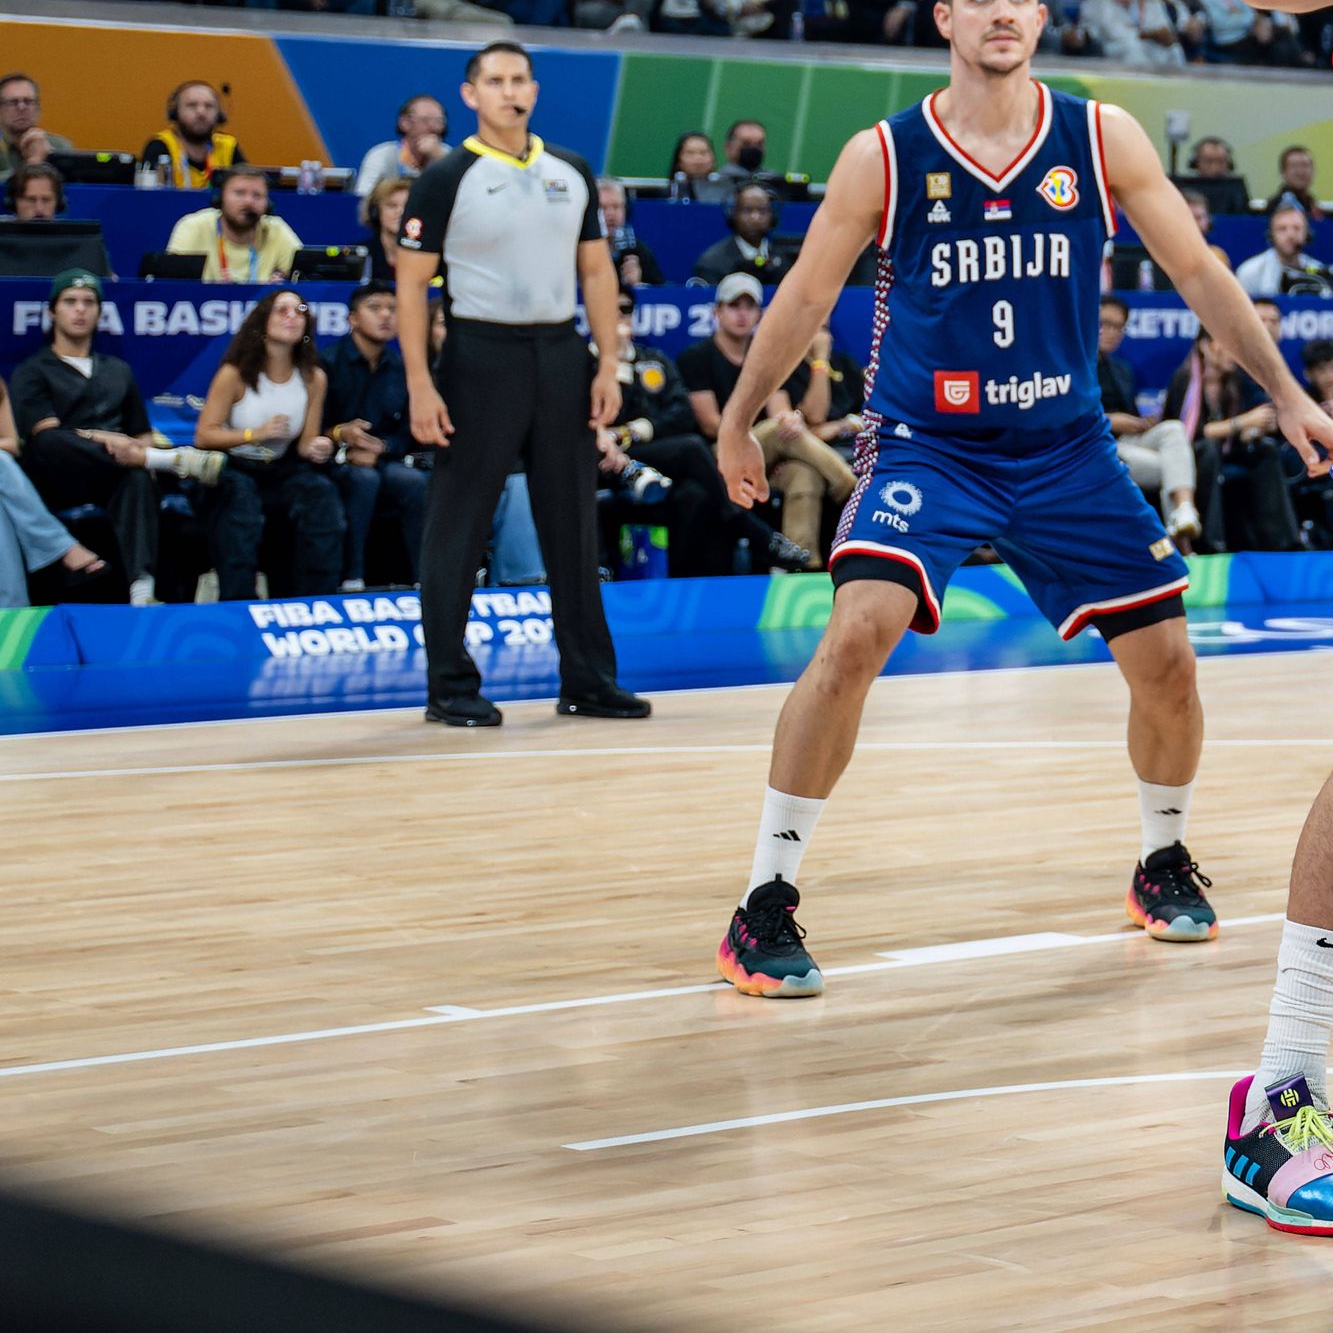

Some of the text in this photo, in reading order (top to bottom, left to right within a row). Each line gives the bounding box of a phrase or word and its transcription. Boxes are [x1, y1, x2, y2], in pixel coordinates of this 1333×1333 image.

[931, 233, 1071, 288] SRBIJA
[992, 300, 1015, 348] 9
[985, 371, 1071, 410] triglav
[872, 510, 909, 533] mts
[248, 600, 343, 629] FIBA
[261, 625, 410, 659] WORLD
